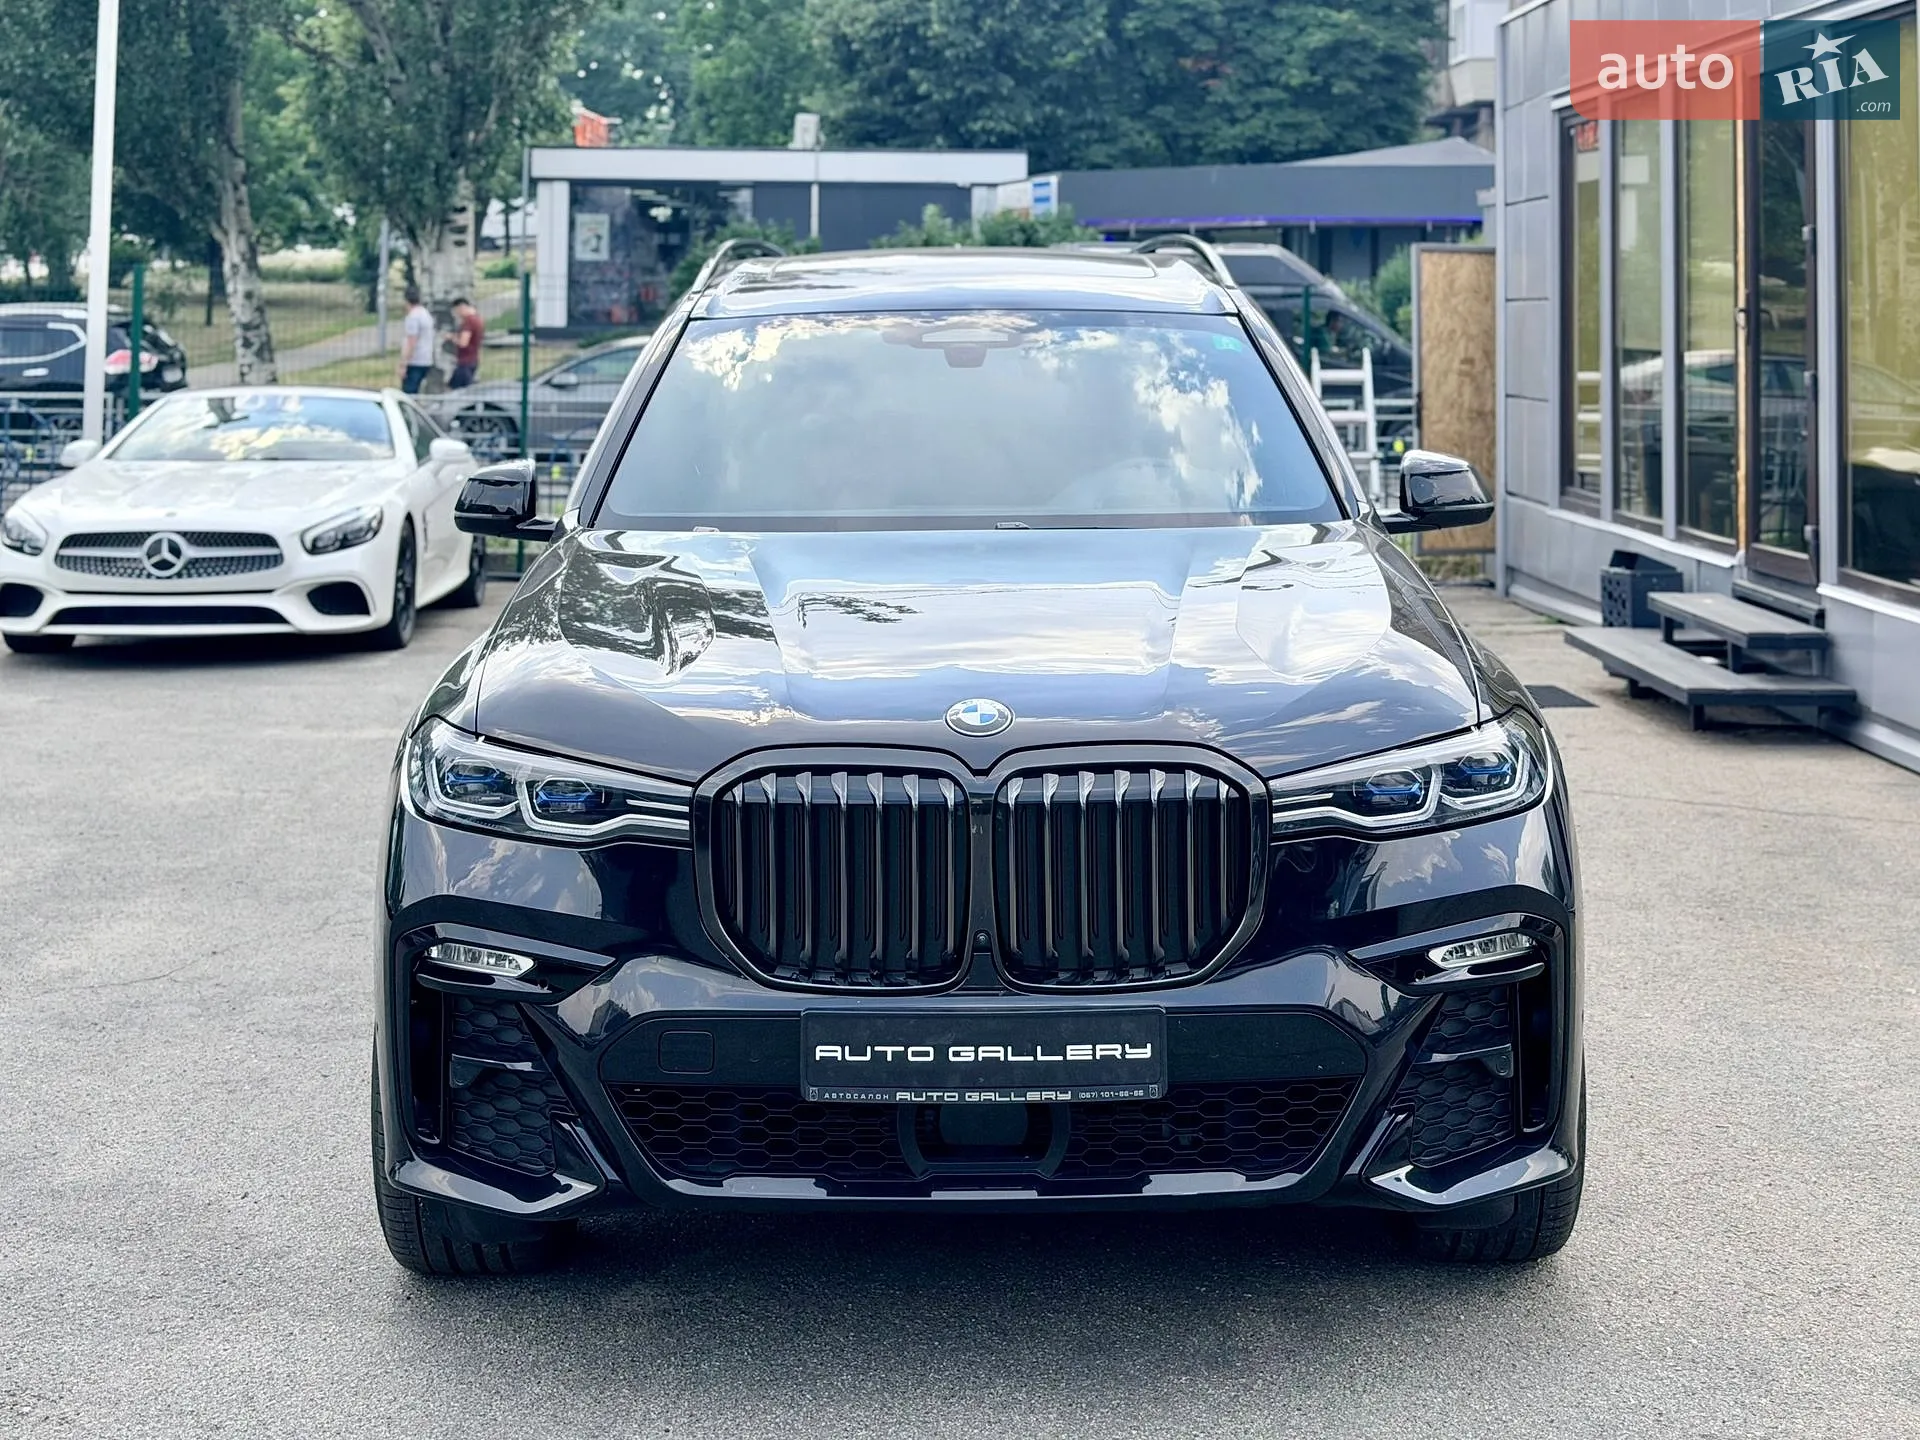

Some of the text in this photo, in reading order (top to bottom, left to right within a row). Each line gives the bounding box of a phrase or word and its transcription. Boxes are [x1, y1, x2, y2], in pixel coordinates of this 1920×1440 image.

[815, 1043, 1152, 1062] AUTO GALLERY
[823, 1092, 889, 1100] АВТОСАЛОН
[895, 1091, 959, 1102] AUTO
[965, 1090, 1072, 1102] GALLERY
